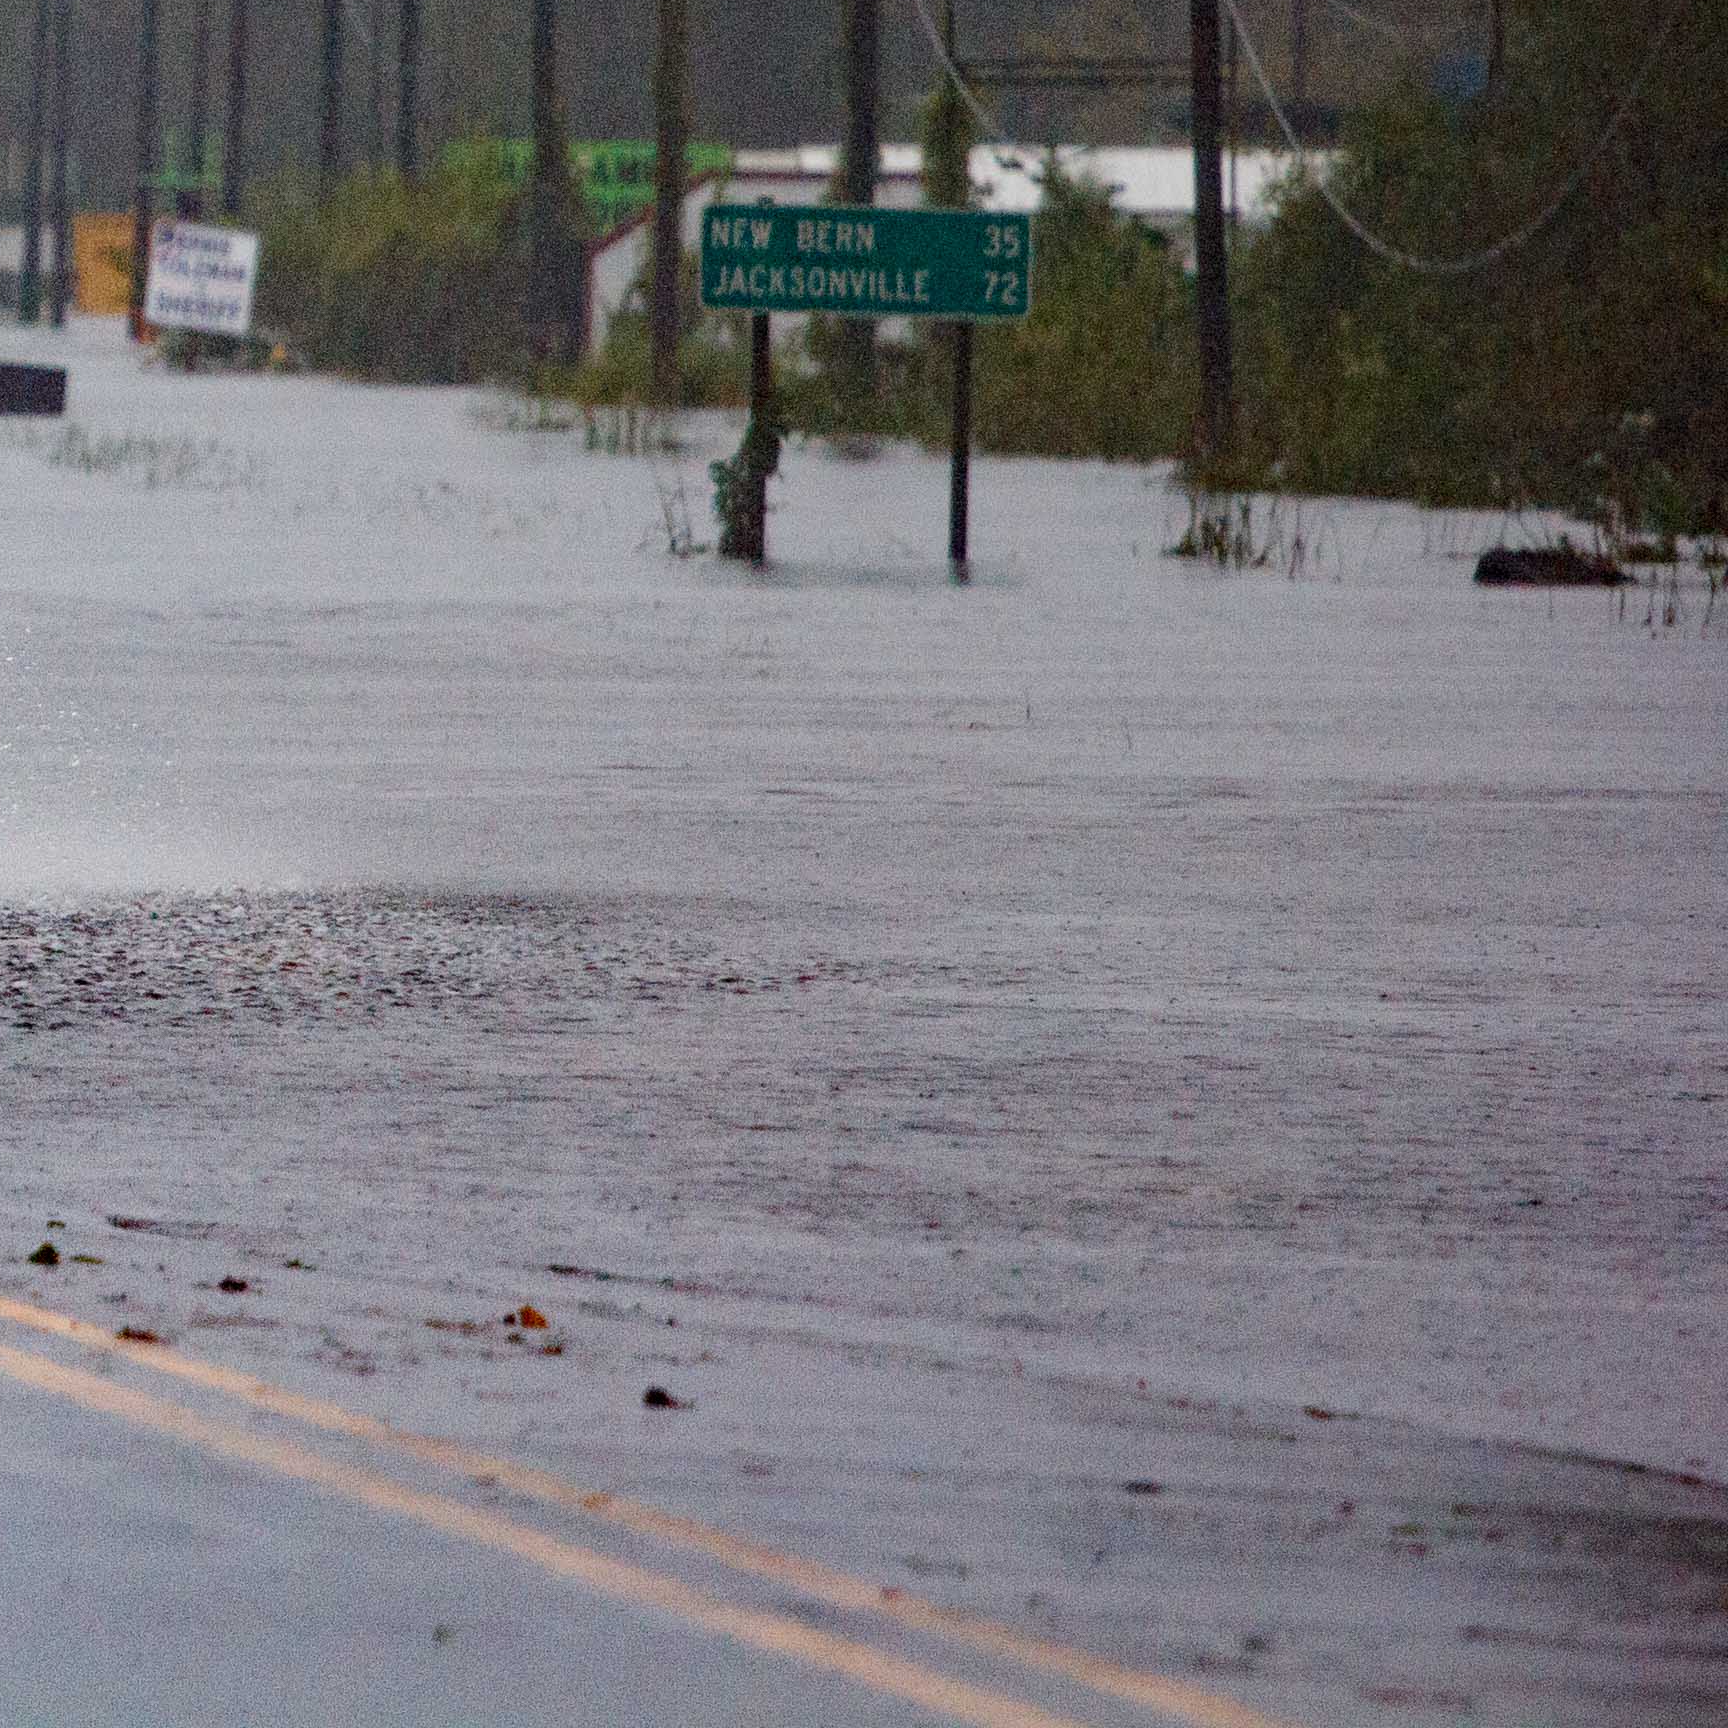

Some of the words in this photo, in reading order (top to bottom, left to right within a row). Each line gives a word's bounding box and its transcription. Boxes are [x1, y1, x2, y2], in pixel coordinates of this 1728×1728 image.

[710, 218, 772, 249] NEW
[796, 220, 875, 254] BERN
[983, 223, 1020, 258] 35
[713, 265, 930, 303] JACKSONVILLE
[984, 271, 1021, 306] 72
